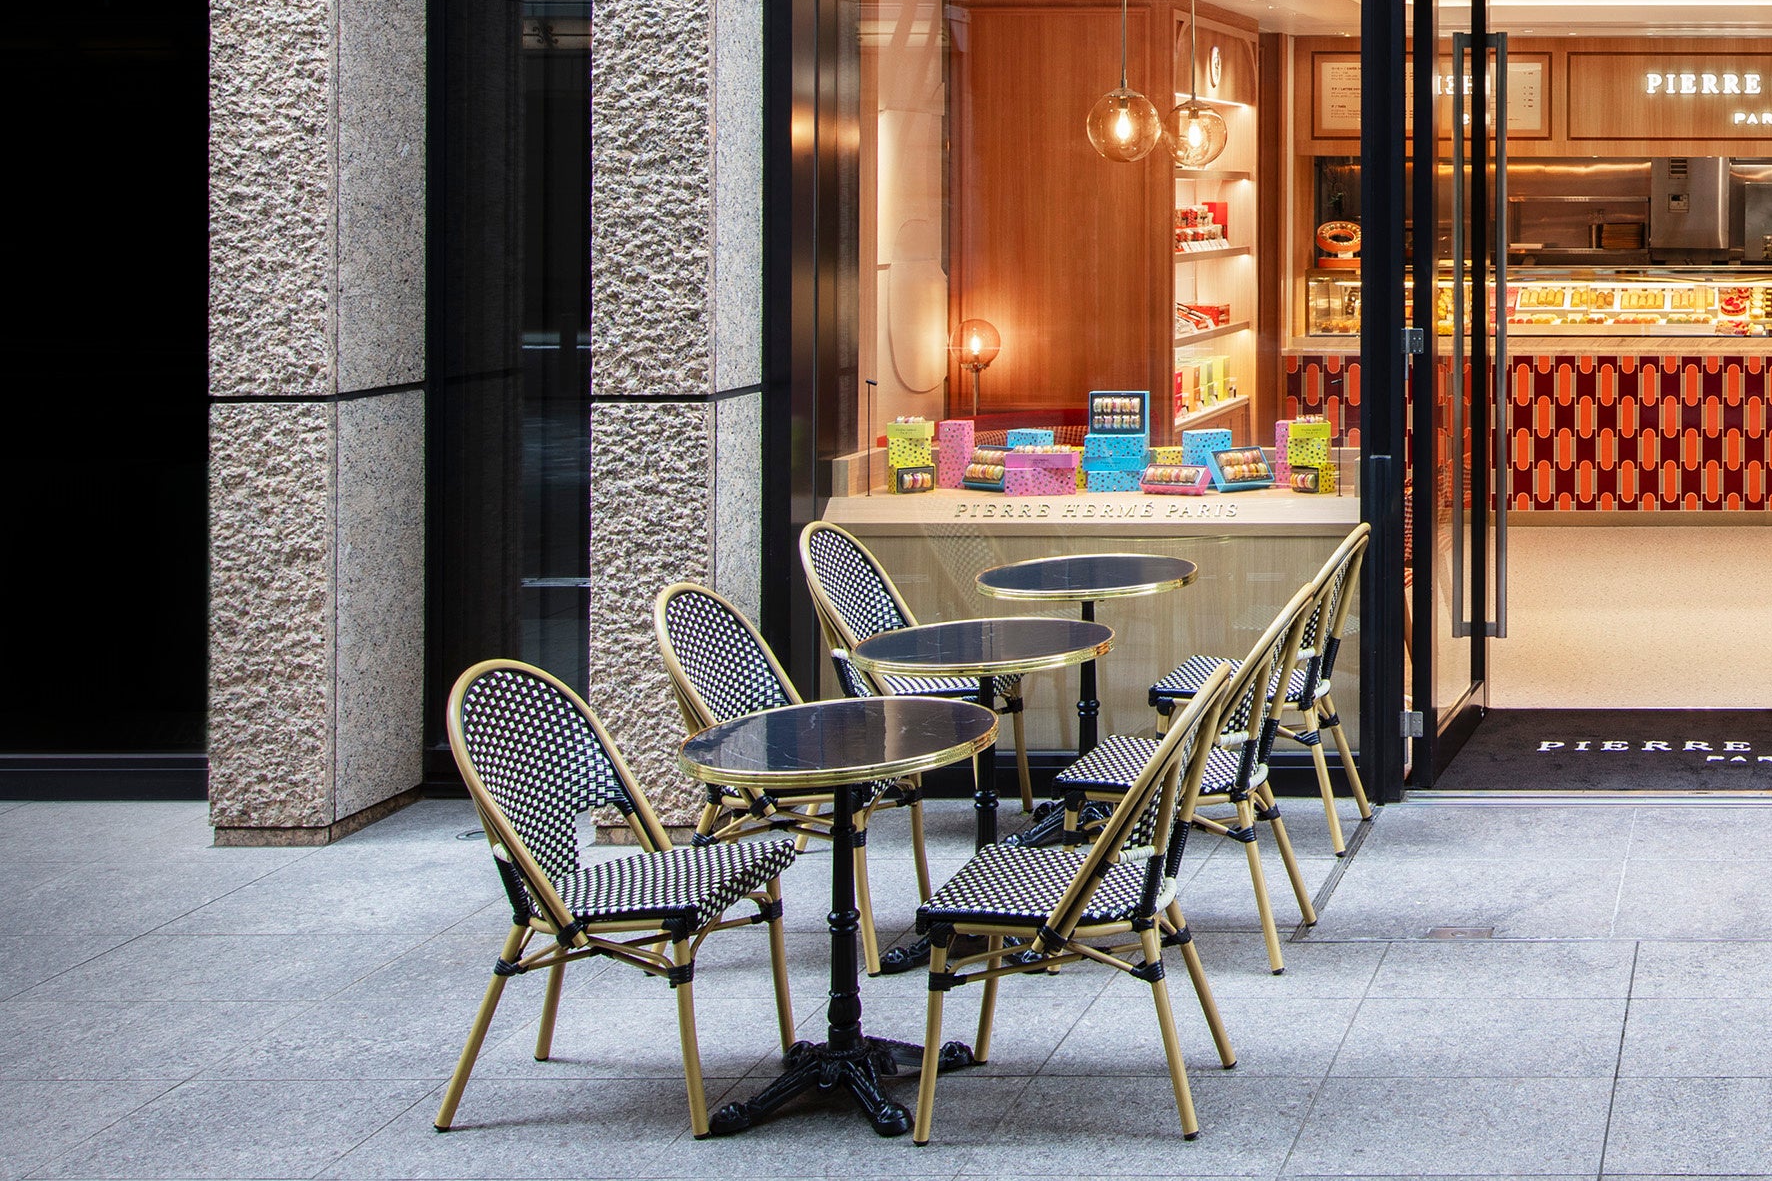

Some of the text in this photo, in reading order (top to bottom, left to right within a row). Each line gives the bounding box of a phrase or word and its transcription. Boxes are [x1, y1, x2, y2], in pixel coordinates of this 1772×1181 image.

[1646, 73, 1761, 94] PIERRE
[955, 502, 1239, 518] PIERRE HERMÉ PARIS
[1536, 740, 1752, 752] PIERRE
